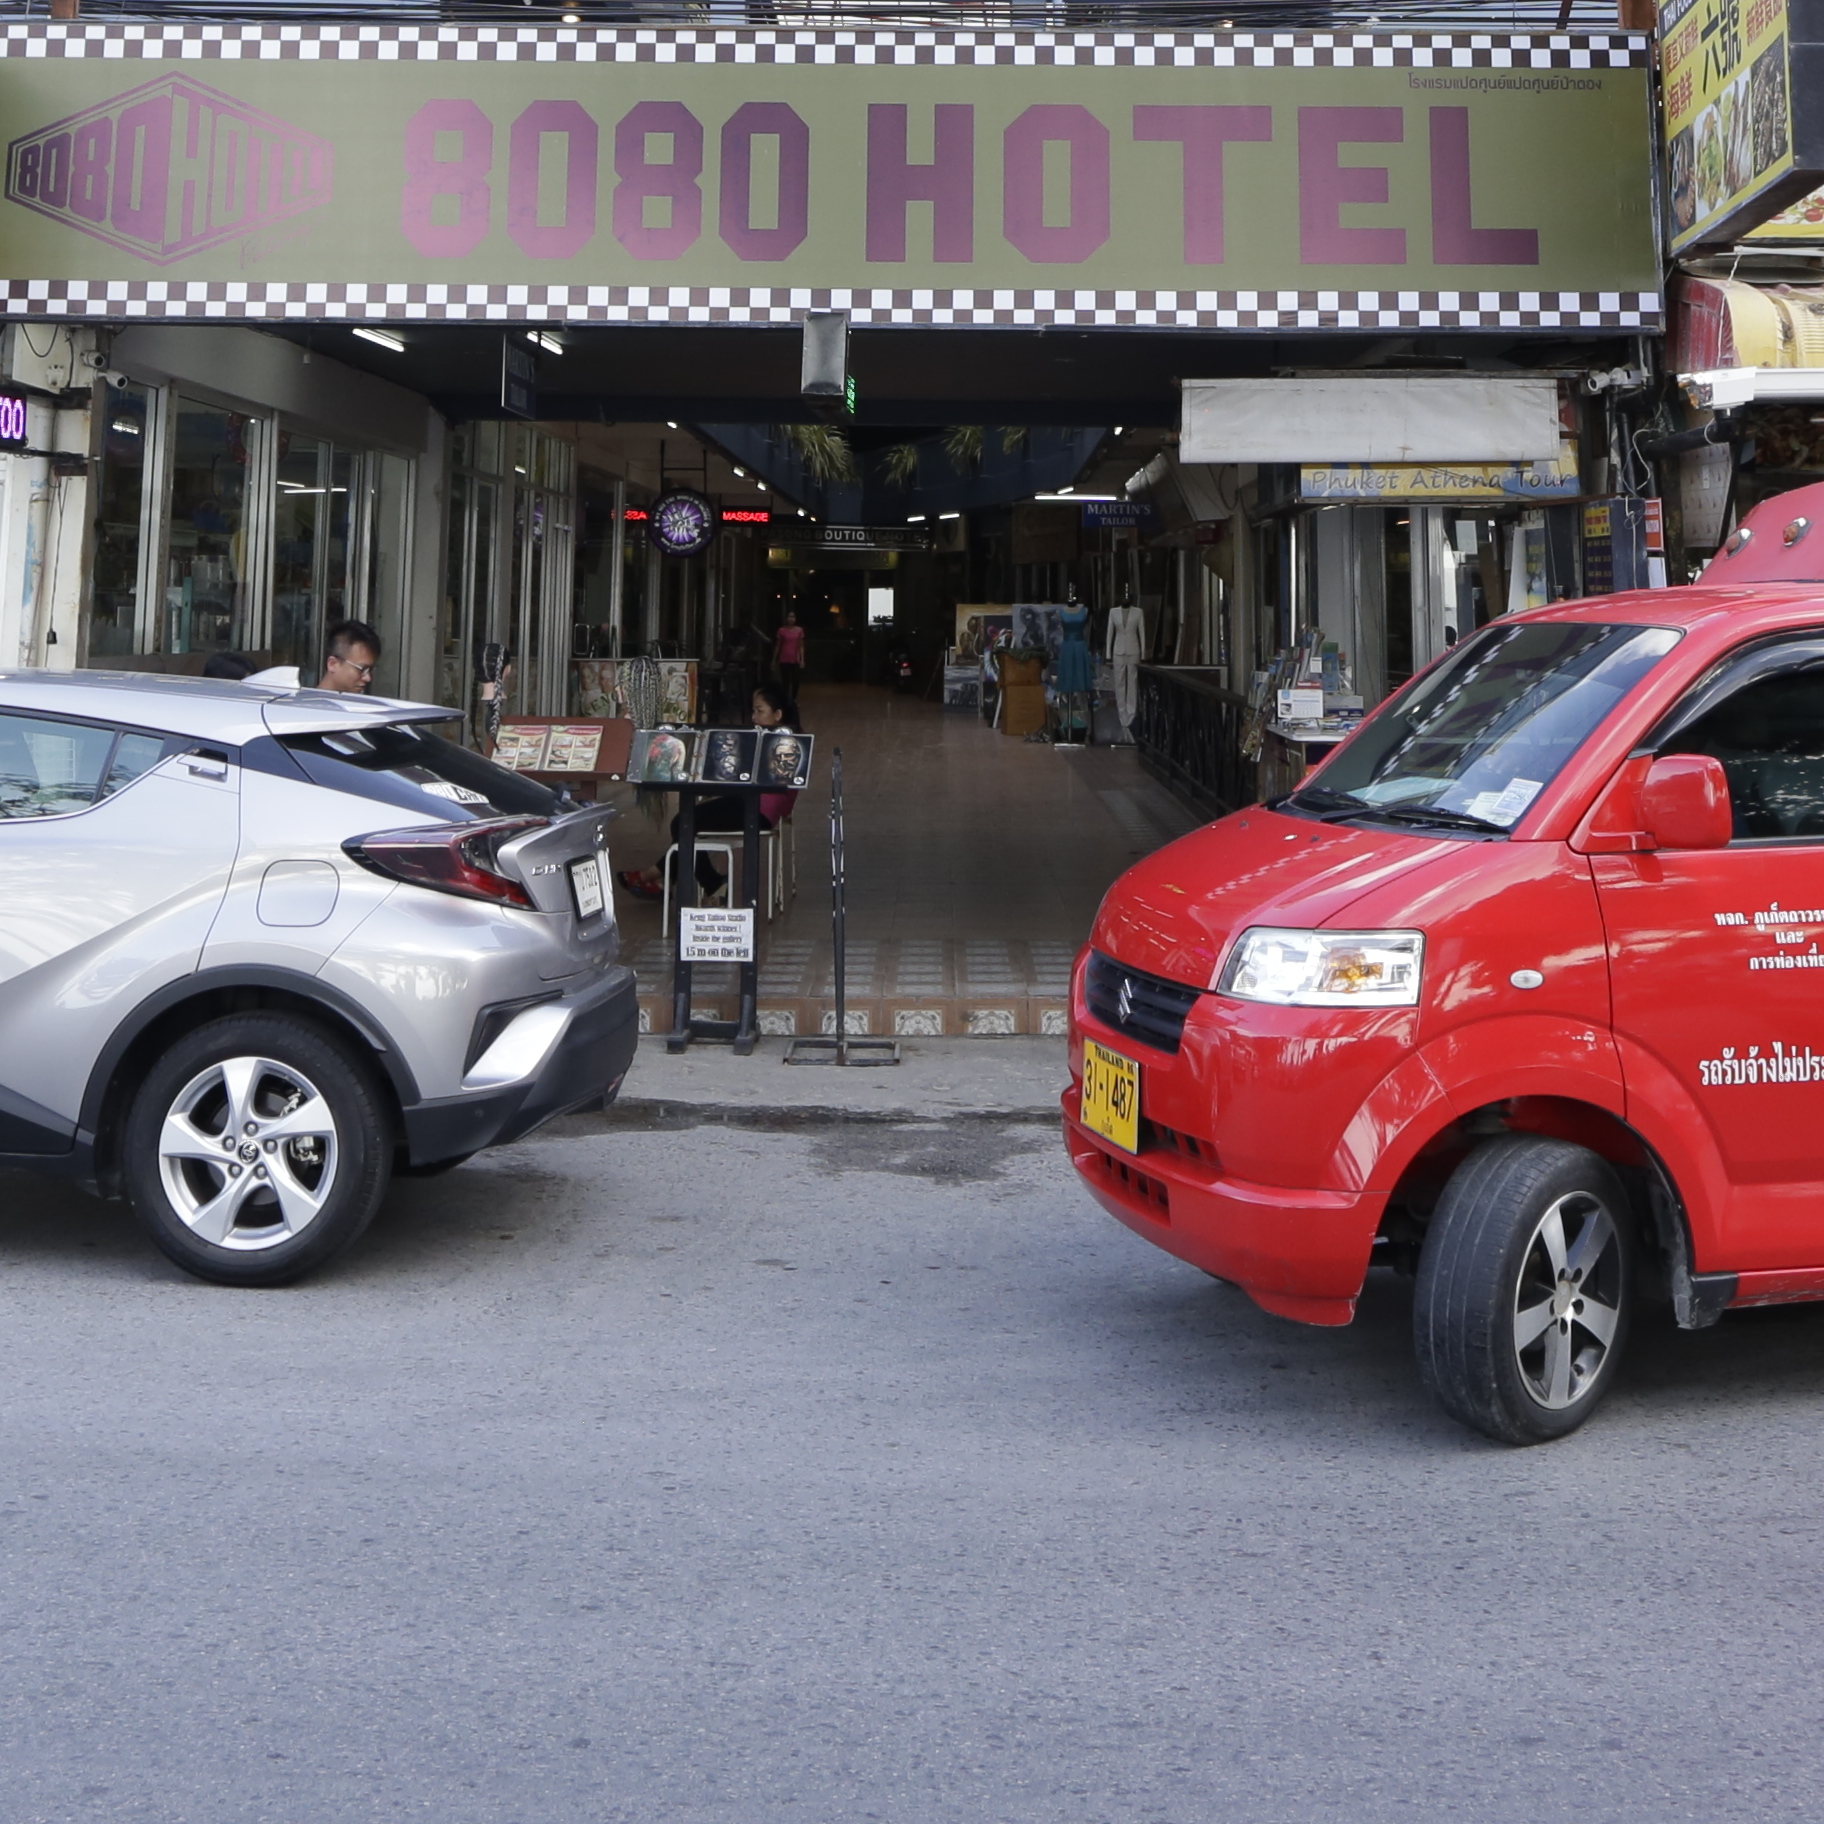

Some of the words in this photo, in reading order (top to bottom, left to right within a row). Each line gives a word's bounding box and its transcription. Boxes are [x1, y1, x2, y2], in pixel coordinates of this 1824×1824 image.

[1663, 0, 1676, 31] THAI
[400, 98, 809, 262] 8080
[866, 104, 1539, 265] HOTEL
[1310, 470, 1397, 490] Phuket
[1409, 470, 1502, 489] Athena
[1514, 469, 1574, 489] Tour
[722, 510, 768, 522] MASSAGE
[1087, 503, 1152, 515] MARTIN'S
[1100, 517, 1136, 526] TAILOR
[1714, 910, 1749, 927] หจก.
[1775, 929, 1805, 944] และ
[1085, 1057, 1135, 1124] 31-1487
